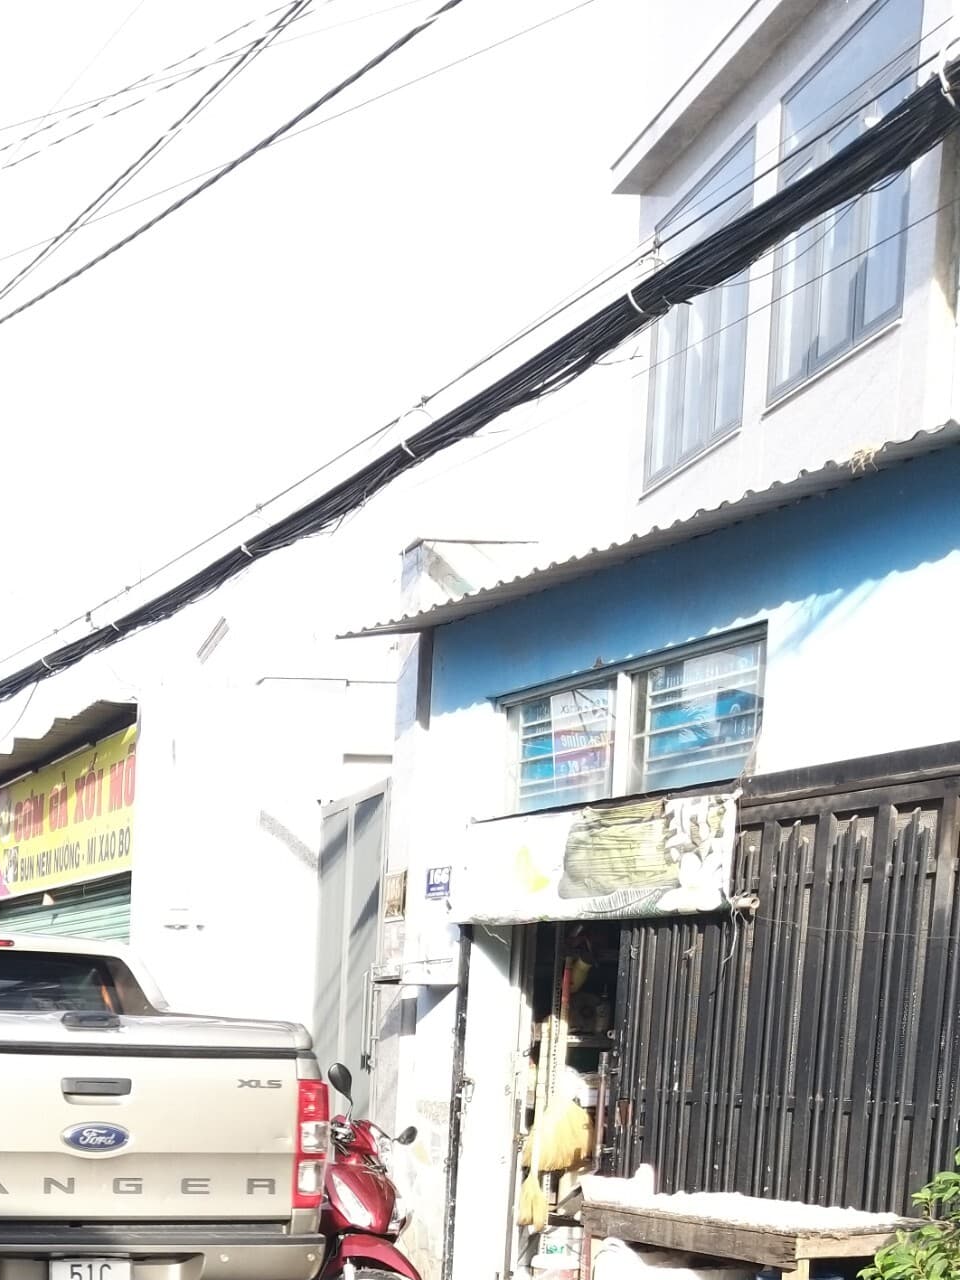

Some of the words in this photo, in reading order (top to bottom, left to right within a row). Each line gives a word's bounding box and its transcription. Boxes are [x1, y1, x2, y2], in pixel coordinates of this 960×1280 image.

[428, 868, 450, 885] 166
[237, 1078, 283, 1089] XLS
[78, 1127, 117, 1146] Ford
